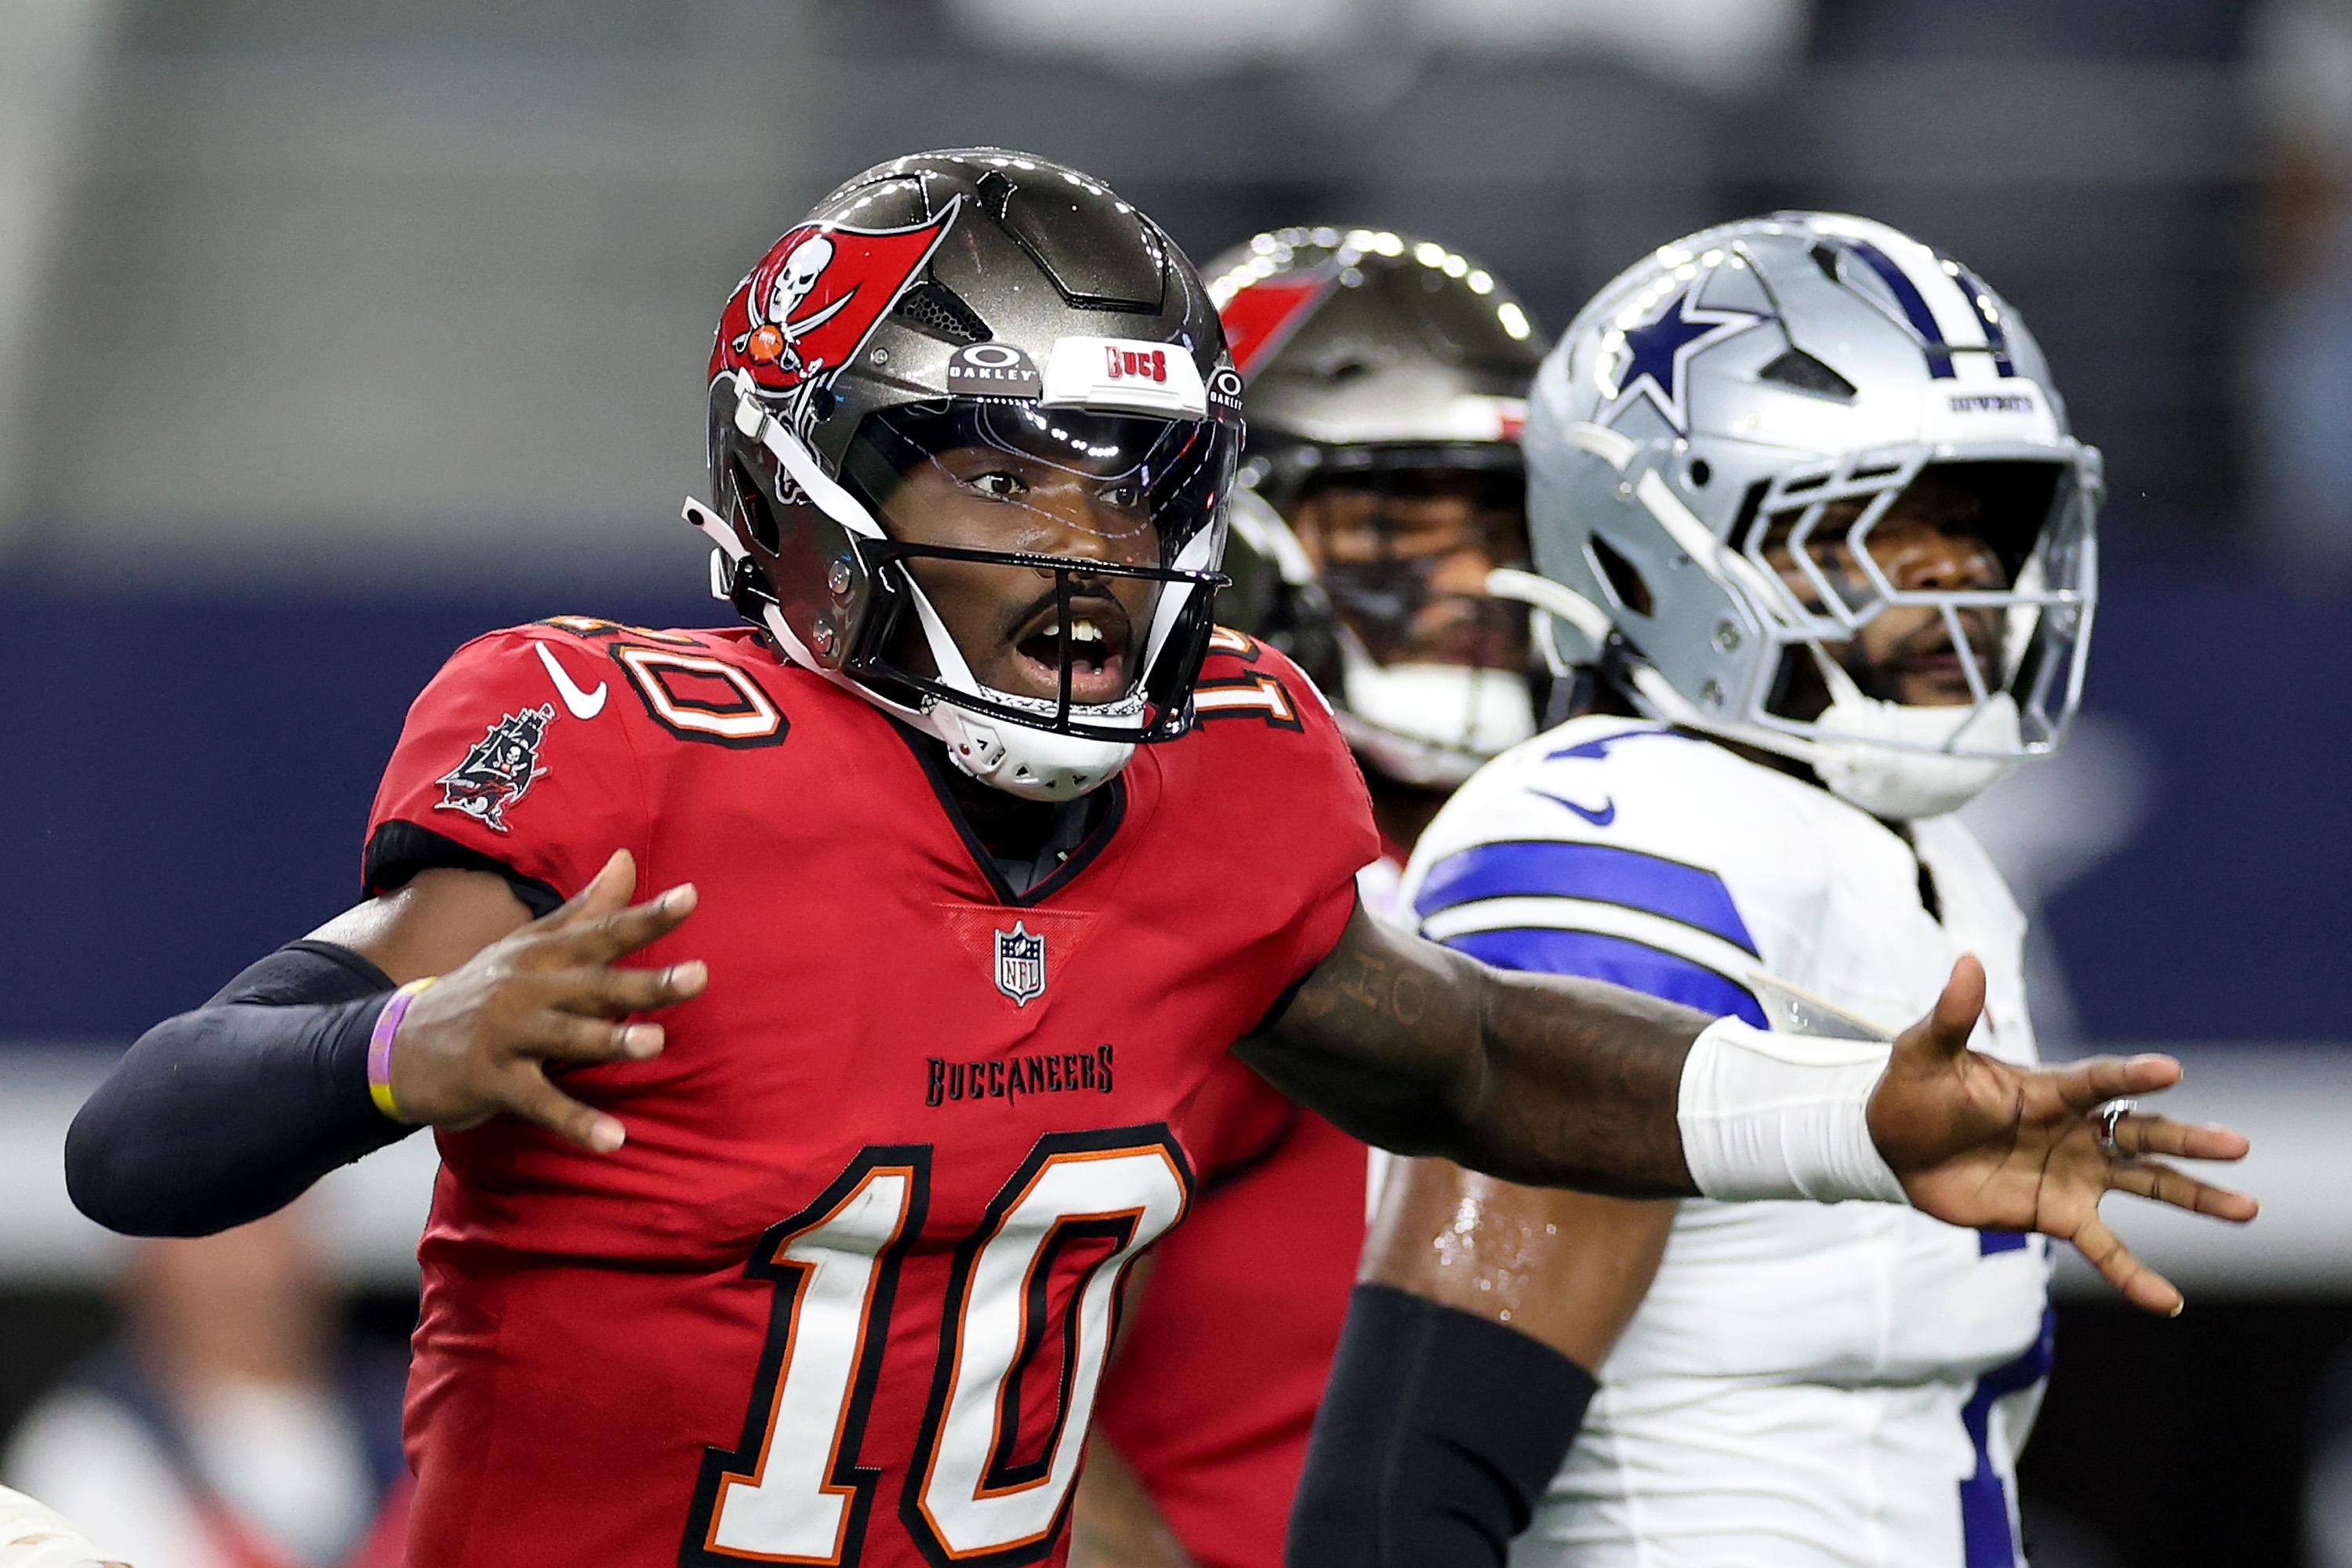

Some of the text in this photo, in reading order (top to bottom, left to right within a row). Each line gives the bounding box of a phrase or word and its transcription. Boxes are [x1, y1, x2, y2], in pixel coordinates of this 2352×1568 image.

[949, 366, 1036, 381] OAKLEY
[1005, 958, 1039, 991] NFL
[678, 1122, 1196, 1568] 10
